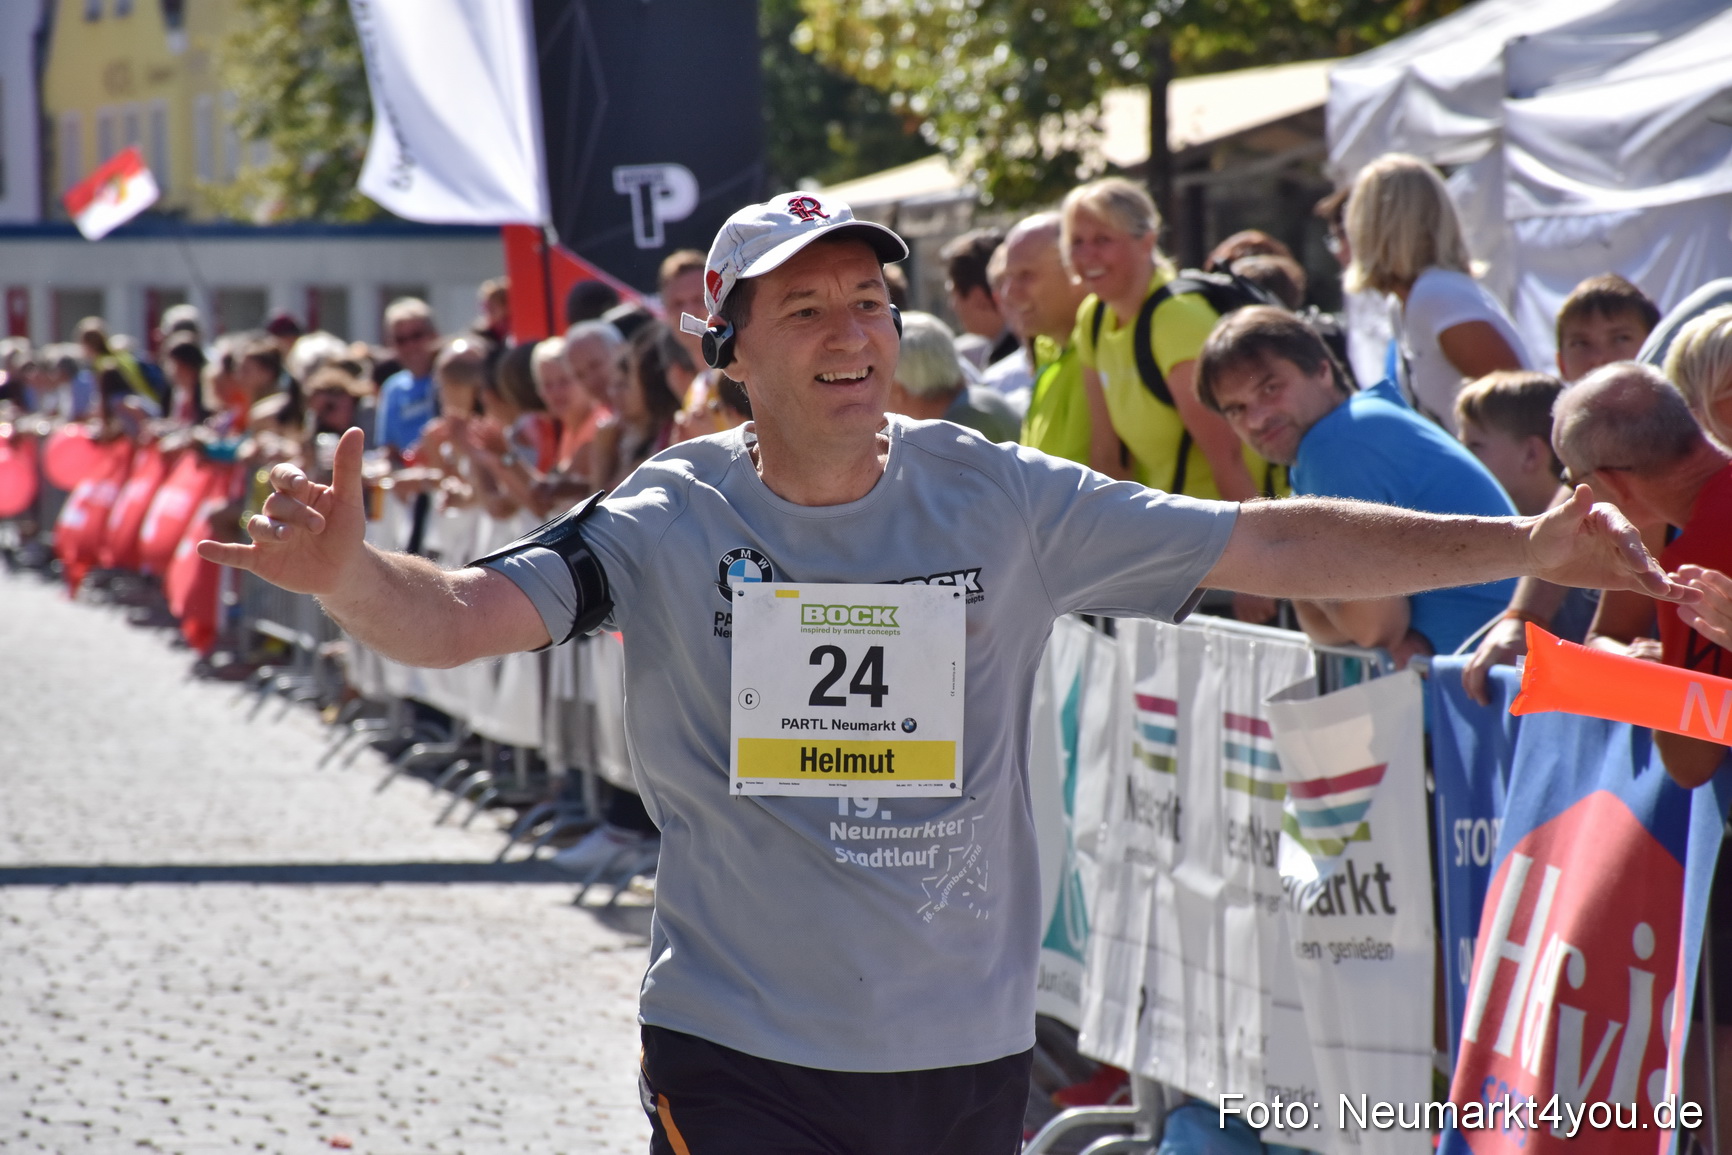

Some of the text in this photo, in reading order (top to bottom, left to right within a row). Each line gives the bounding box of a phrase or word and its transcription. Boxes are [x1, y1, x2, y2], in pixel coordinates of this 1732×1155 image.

[722, 549, 770, 571] BMW
[801, 604, 900, 627] BOCK
[713, 626, 733, 639] Ne
[800, 626, 901, 637] inspired by smart concepts
[808, 645, 889, 708] 24
[781, 718, 897, 731] PARTL Neumarkt
[800, 747, 895, 774] Helmut
[829, 818, 965, 841] Neumarkter
[834, 845, 941, 869] Stadtlauf
[922, 844, 982, 923] 16. September 2018
